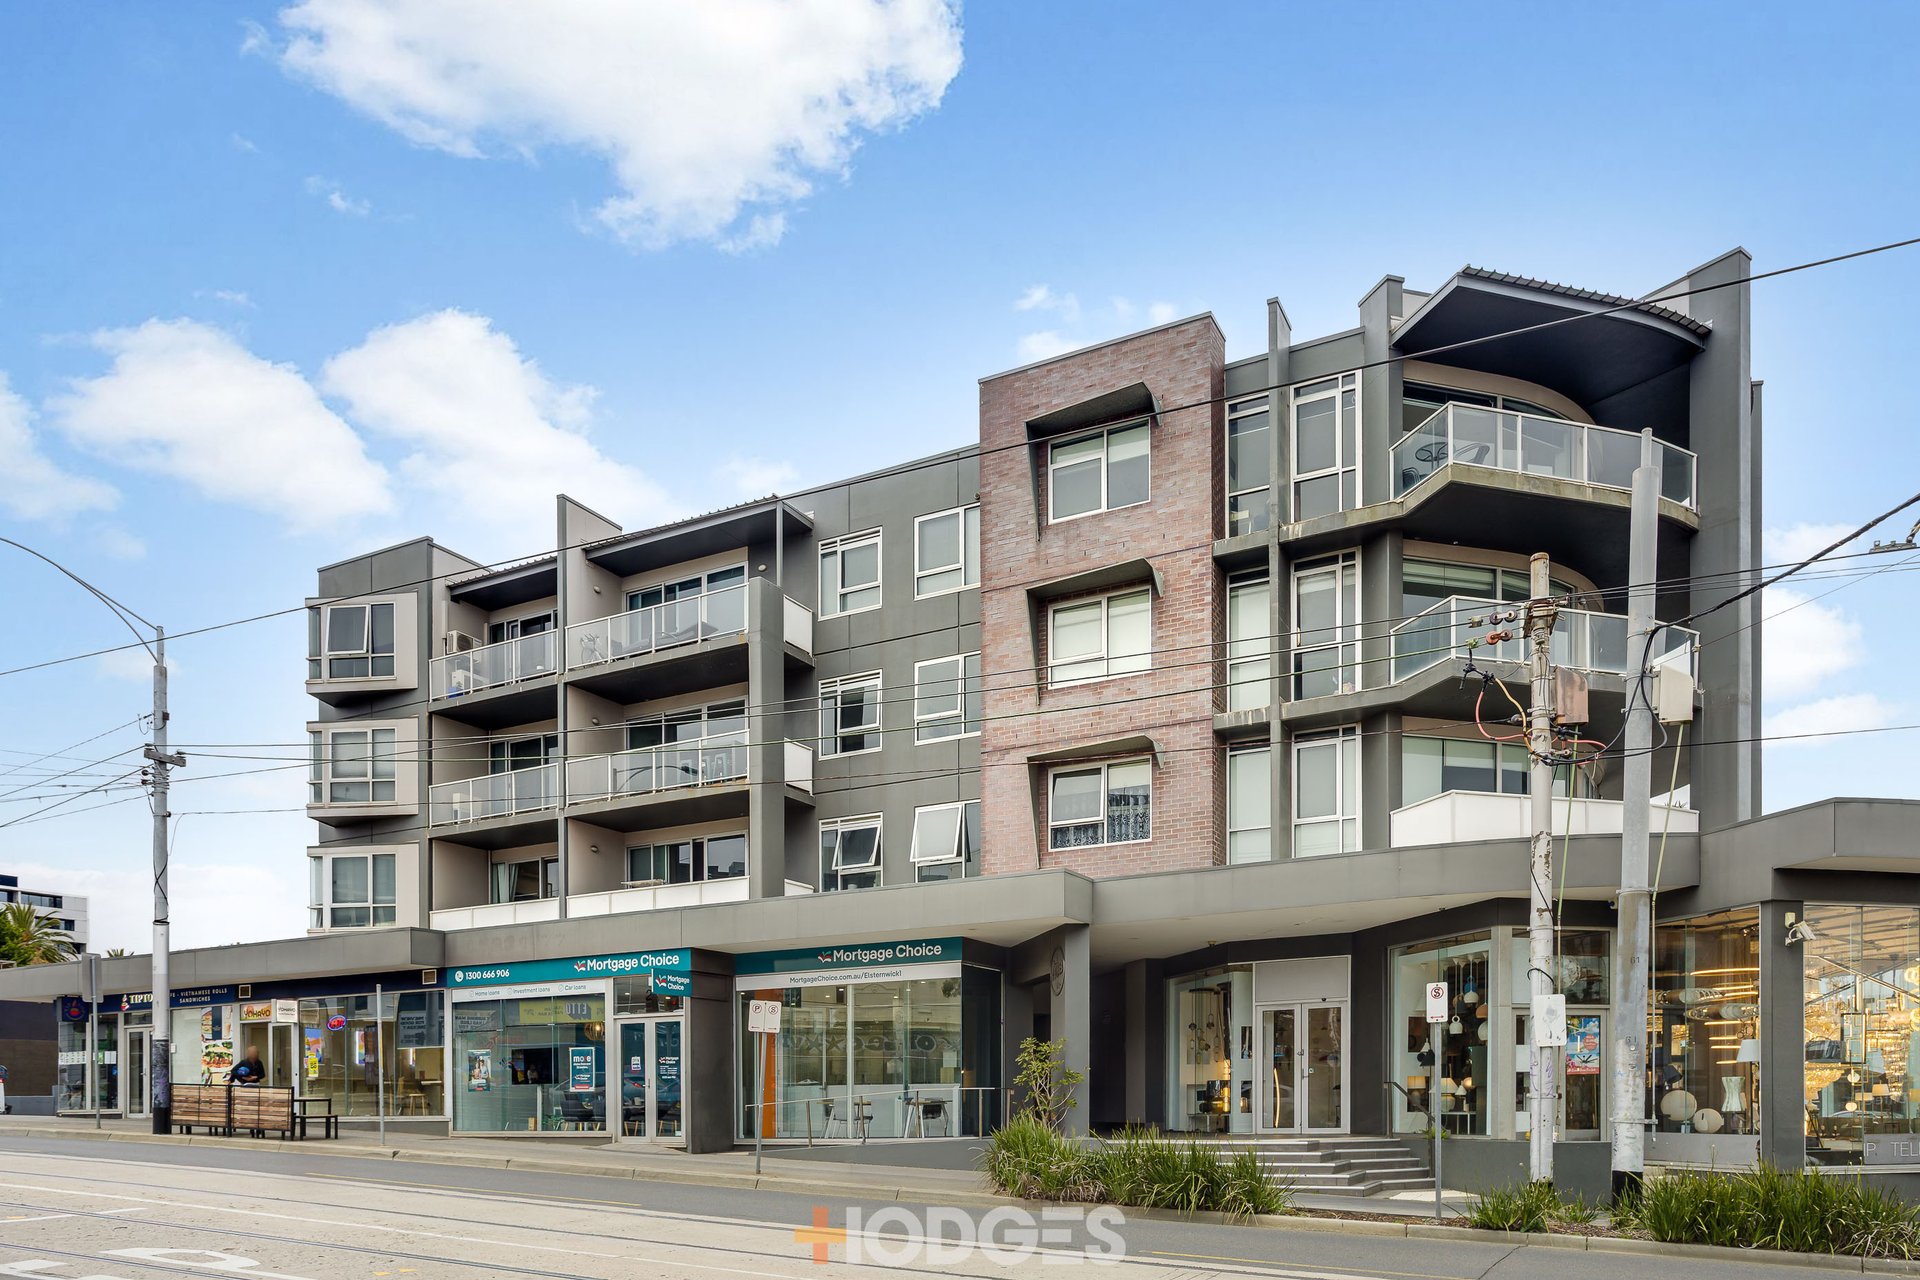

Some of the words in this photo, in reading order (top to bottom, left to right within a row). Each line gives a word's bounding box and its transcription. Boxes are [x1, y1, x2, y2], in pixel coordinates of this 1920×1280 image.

[833, 949, 893, 962] Mortgage
[895, 943, 942, 957] Choice
[587, 958, 639, 972] Mortgage
[640, 953, 680, 967] Choice
[465, 972, 481, 980] 1300
[482, 971, 496, 979] 666
[496, 969, 510, 977] 906
[667, 974, 690, 984] Mortgage
[667, 983, 685, 991] Choice
[180, 989, 211, 997] VIETNAMESE
[179, 996, 211, 1004] SANDWICHES
[1890, 1141, 1920, 1157] TEL
